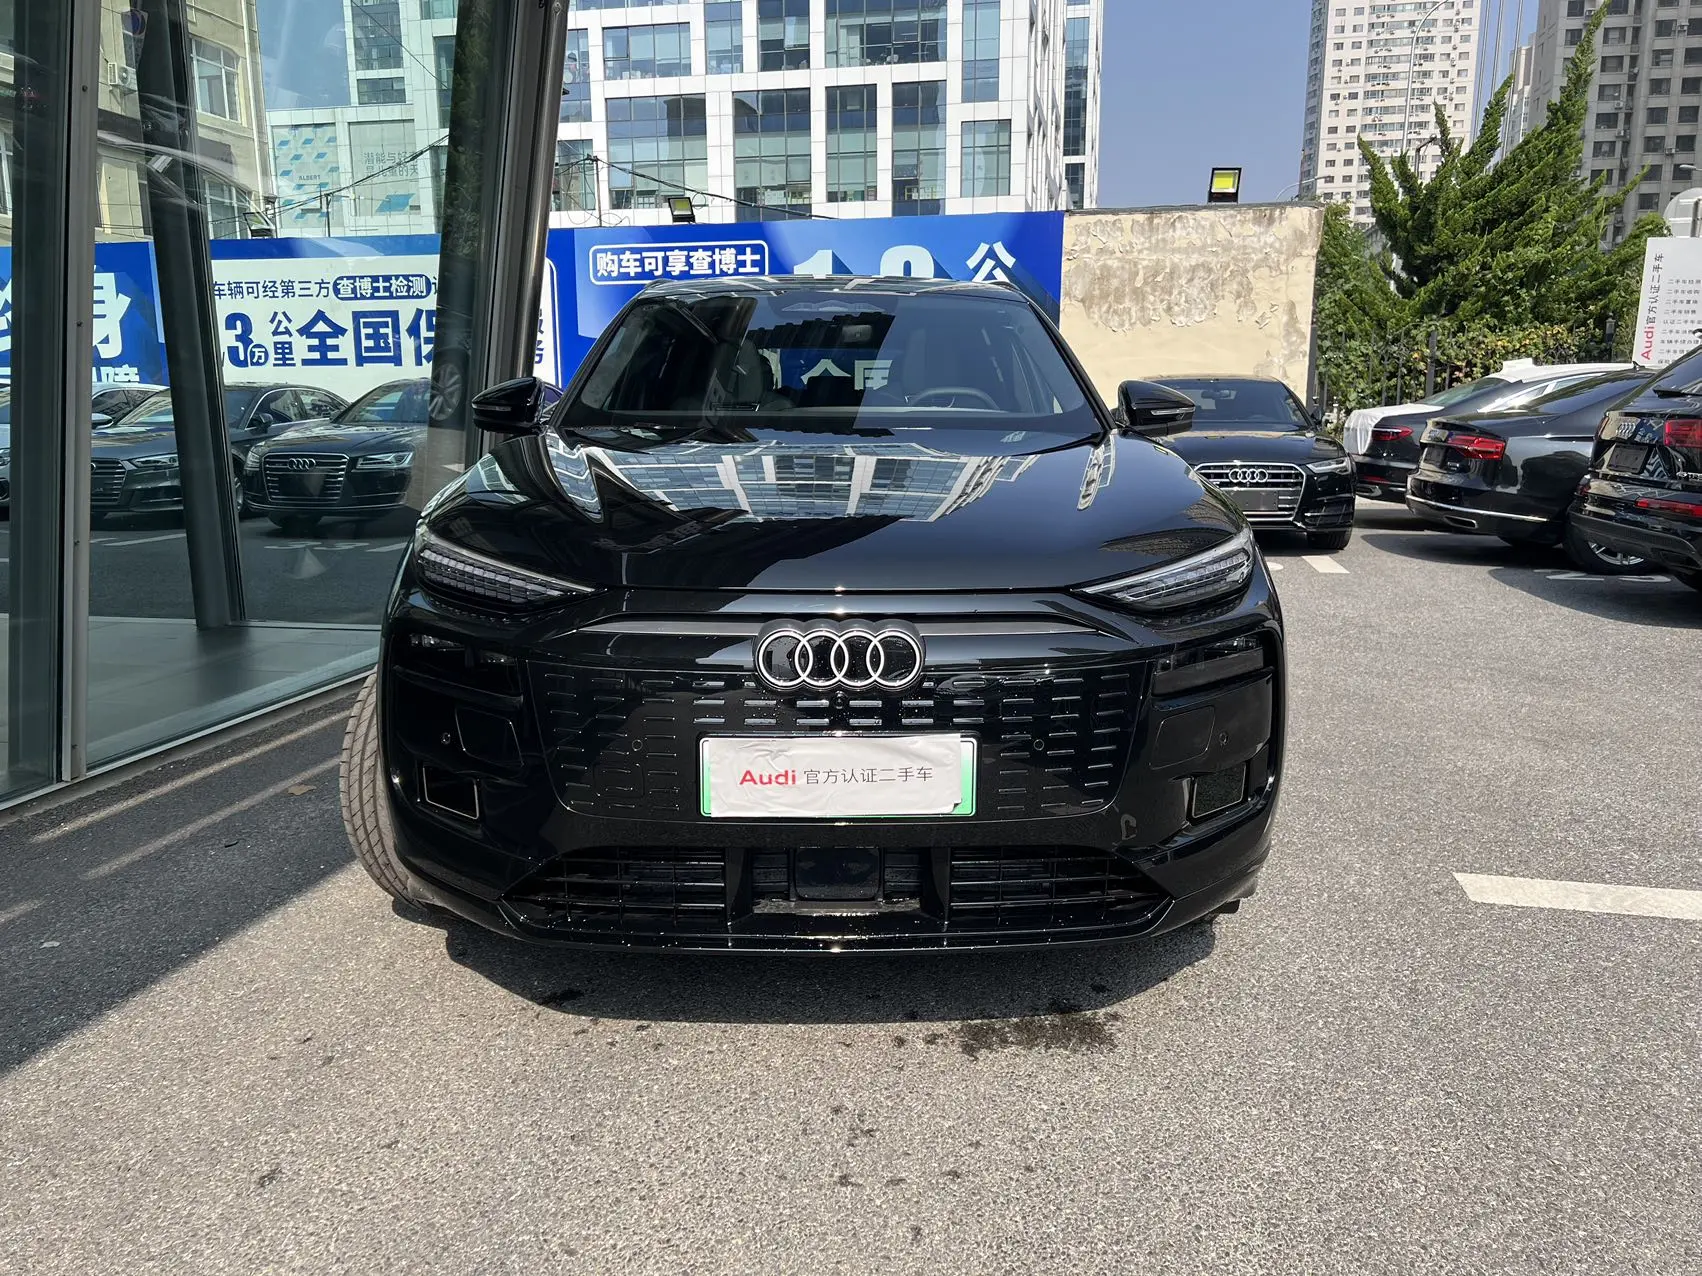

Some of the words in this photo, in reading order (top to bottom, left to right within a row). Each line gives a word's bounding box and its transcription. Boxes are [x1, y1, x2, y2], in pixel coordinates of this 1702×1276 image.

[596, 246, 761, 277] 购车可享查博士
[1646, 252, 1664, 325] 官方认证二手车
[1641, 326, 1655, 360] Audi
[740, 769, 796, 785] Audi
[803, 767, 933, 785] 官方认证二手车
